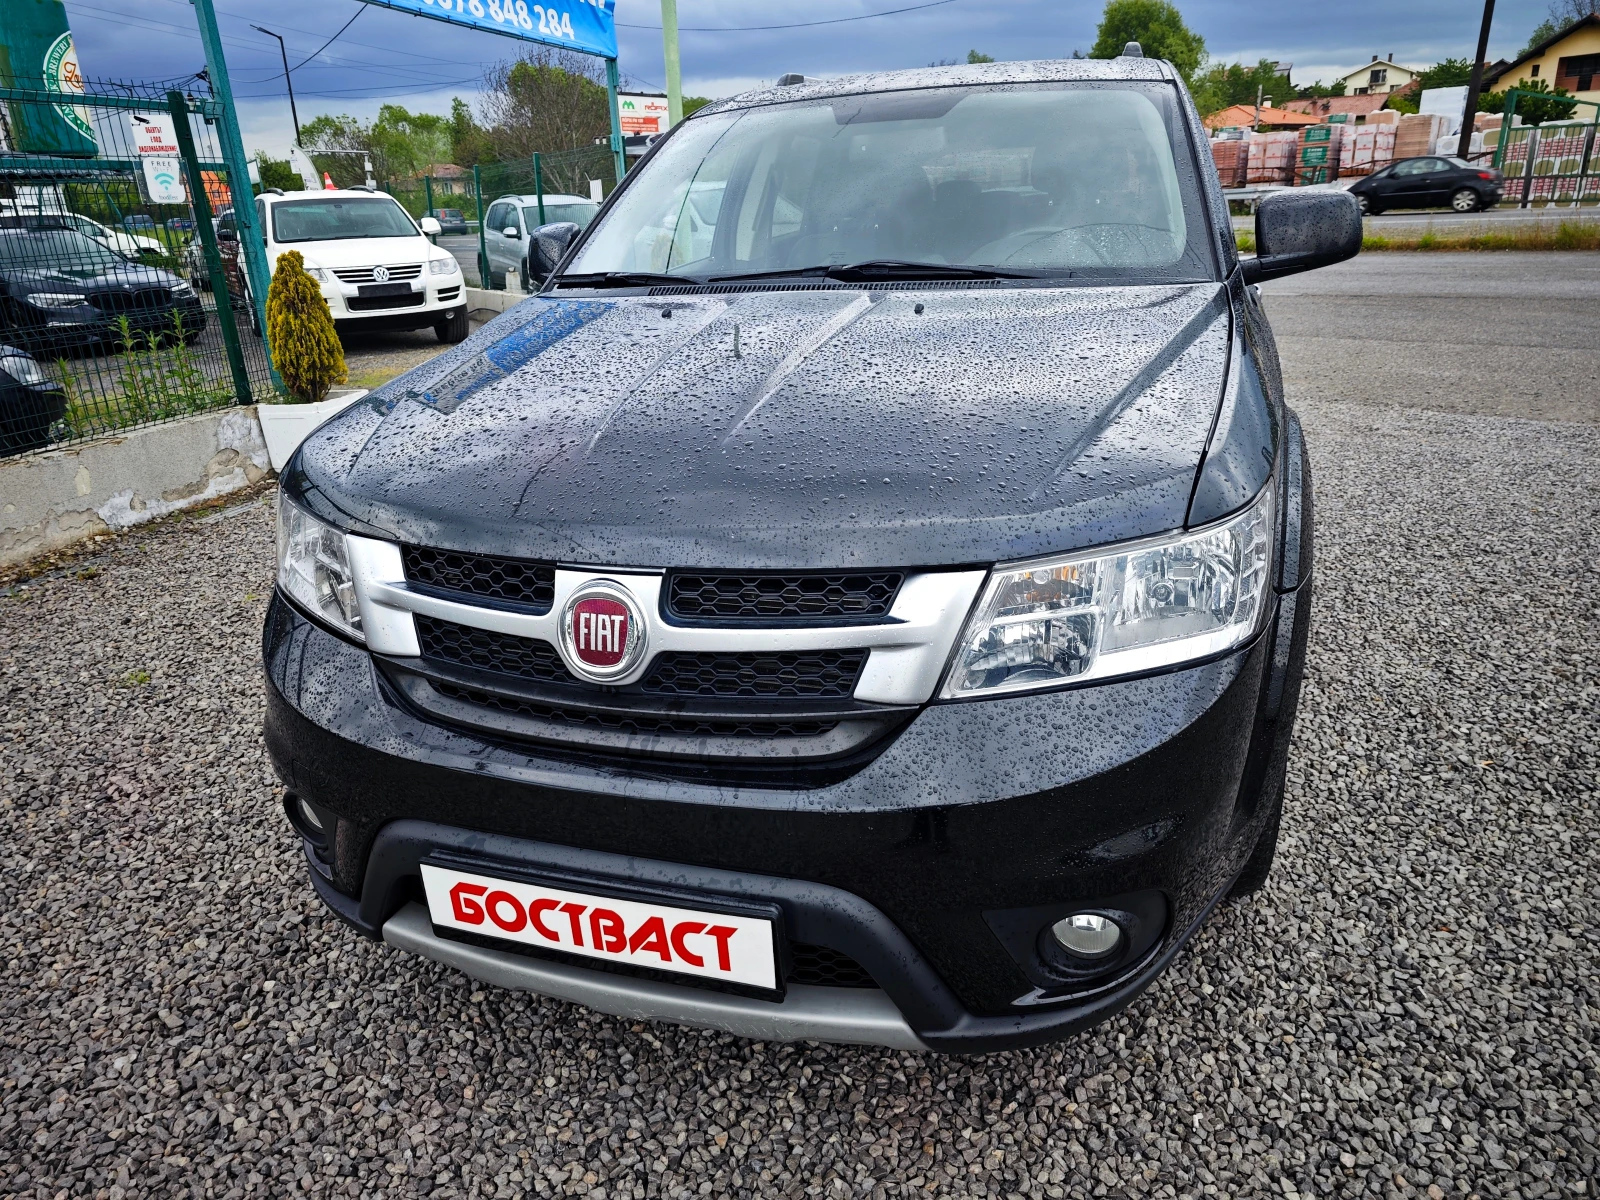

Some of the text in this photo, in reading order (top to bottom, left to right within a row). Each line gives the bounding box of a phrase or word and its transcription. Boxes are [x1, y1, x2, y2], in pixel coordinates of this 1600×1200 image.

[487, 0, 532, 30] 848
[534, 5, 575, 40] 284
[579, 612, 625, 653] FIAT
[449, 881, 739, 972] БОСТВАСТ
